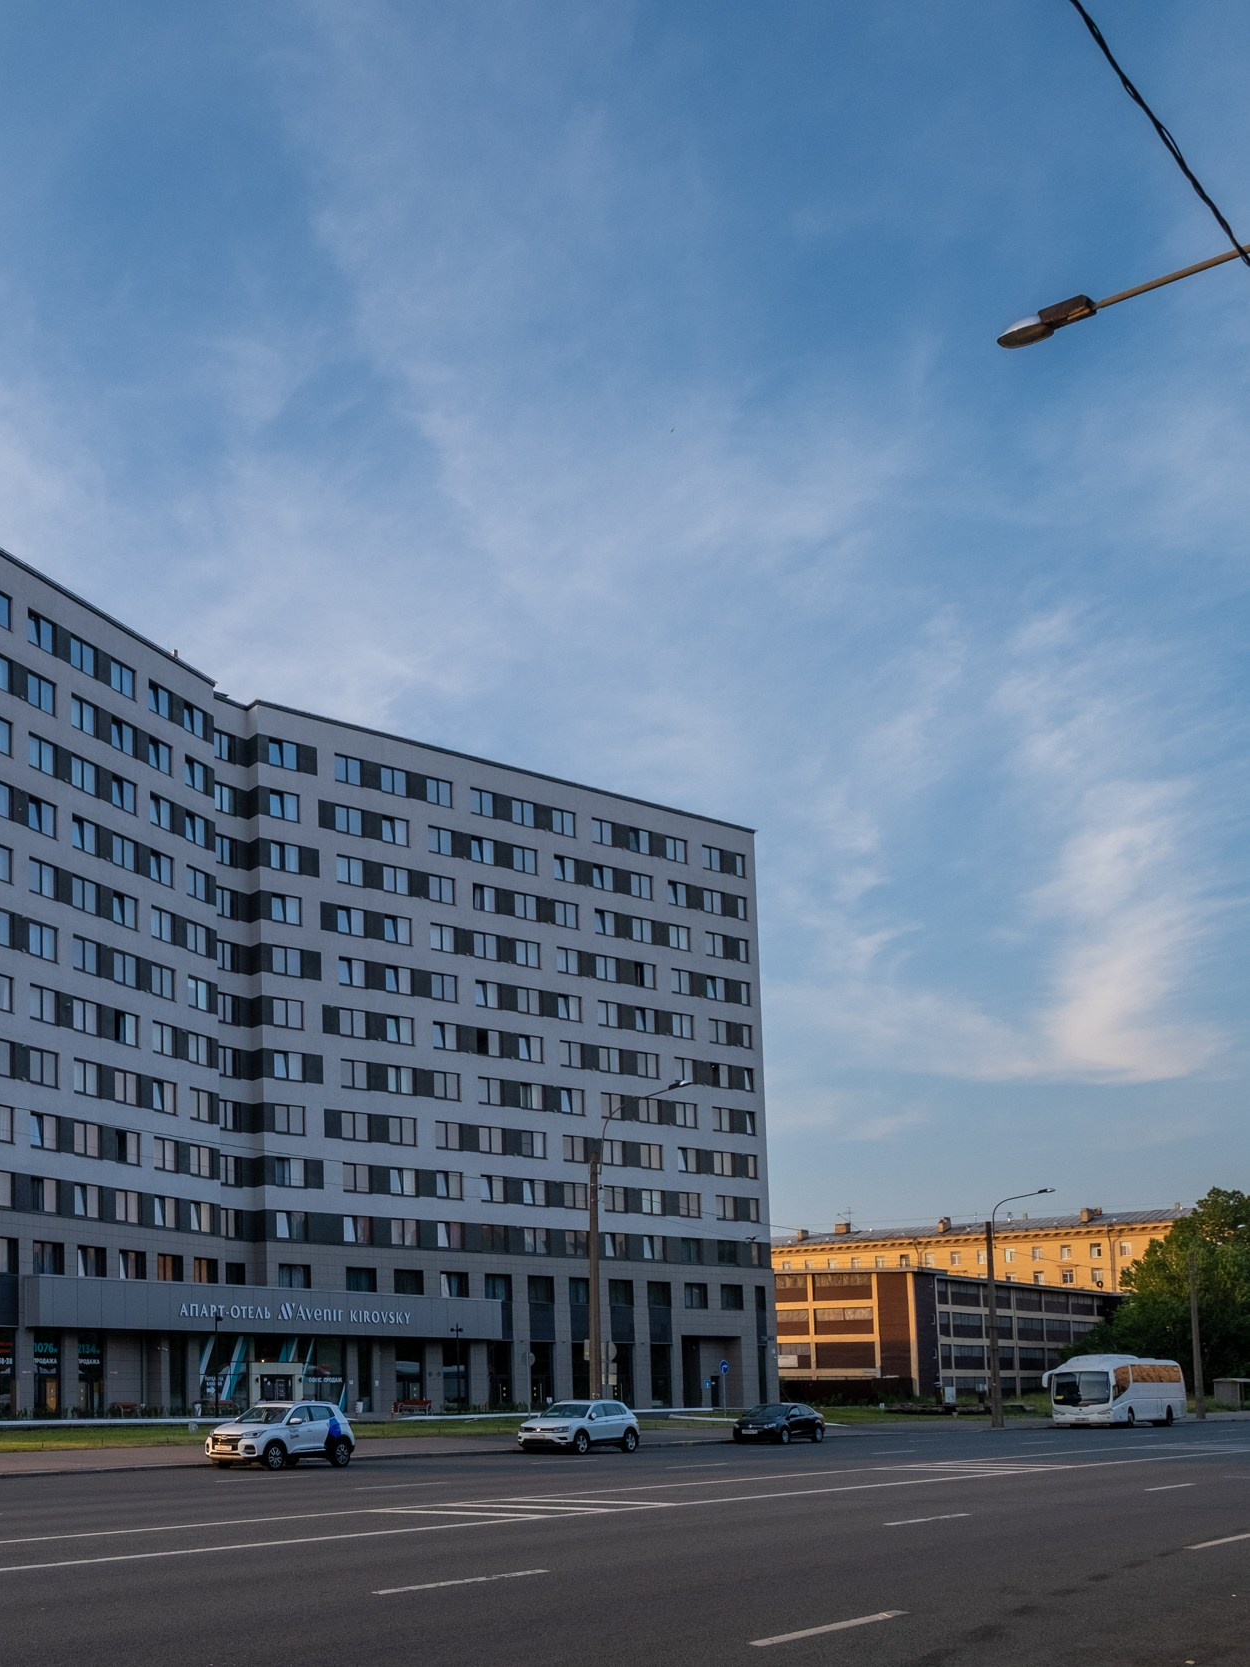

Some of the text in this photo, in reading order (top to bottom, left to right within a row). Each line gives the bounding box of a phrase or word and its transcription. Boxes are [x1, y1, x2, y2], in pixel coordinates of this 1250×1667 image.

[179, 1303, 411, 1324] АПАРТ-ОТЕЛЬ Avenir KIROVSKY
